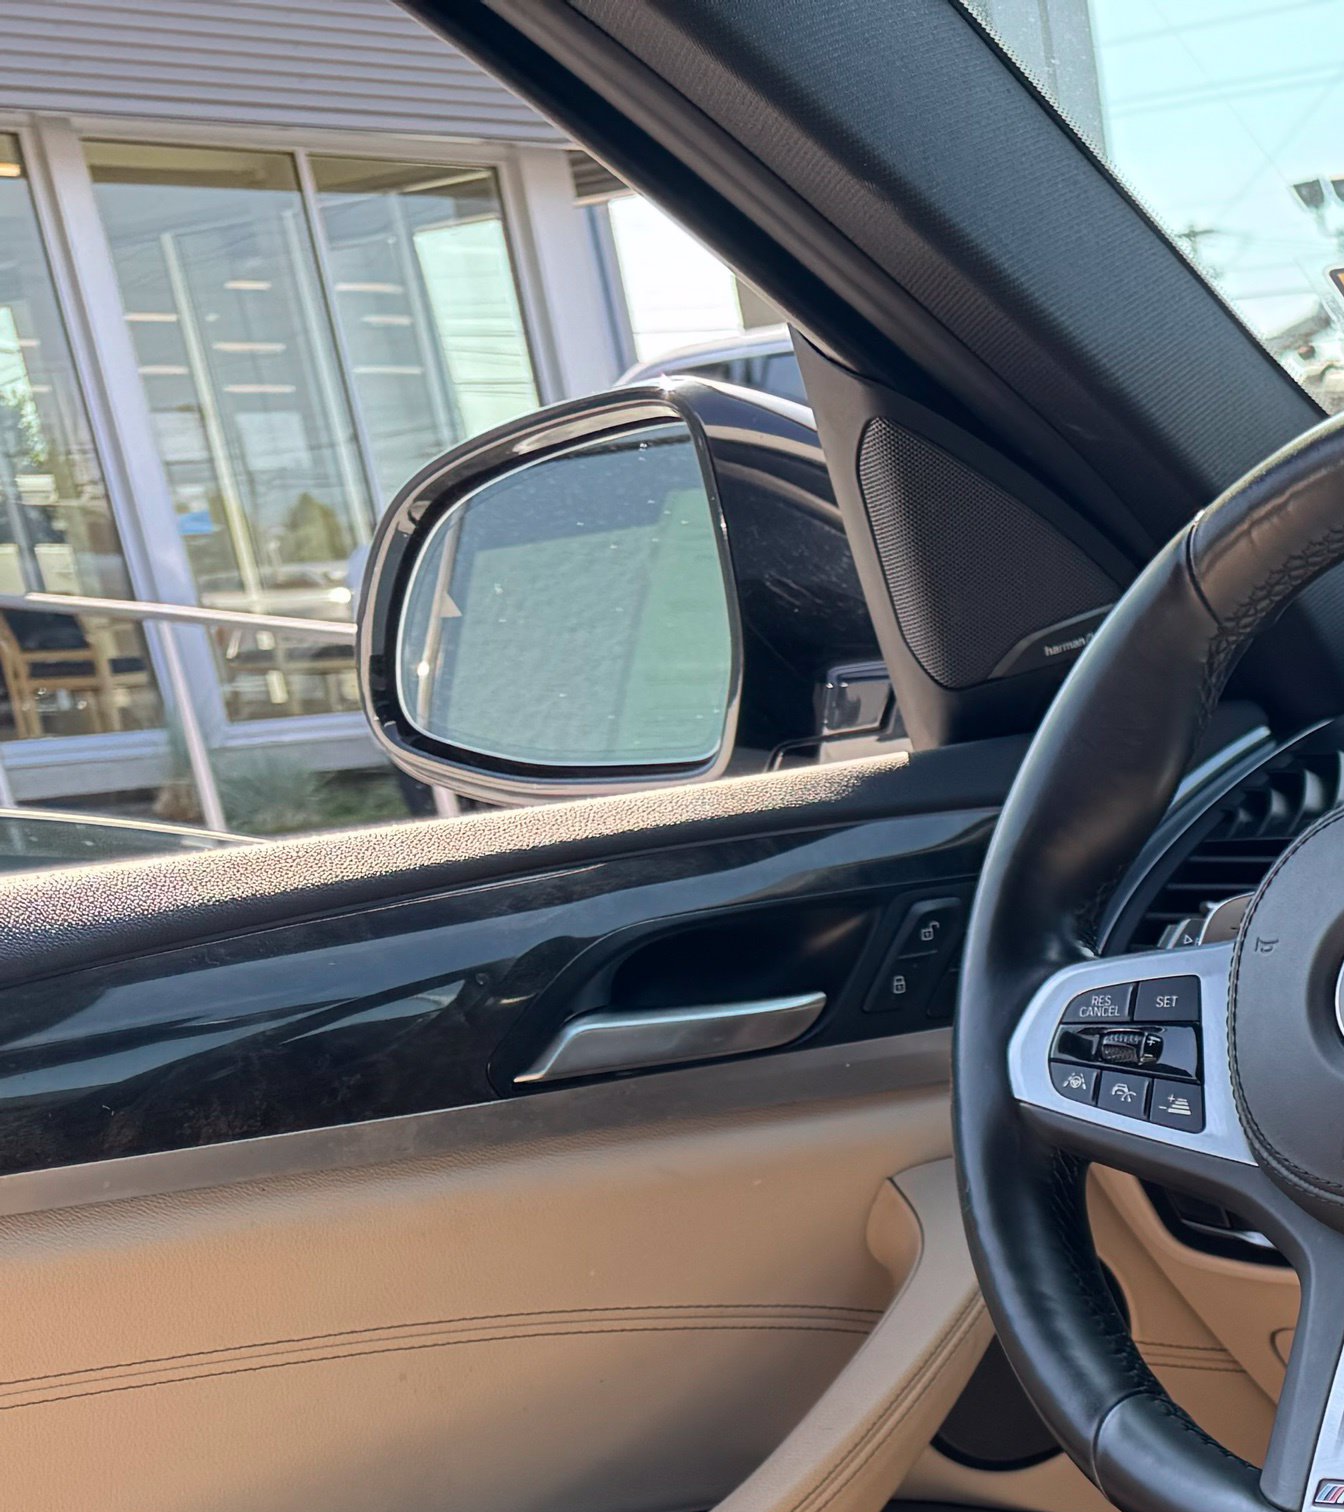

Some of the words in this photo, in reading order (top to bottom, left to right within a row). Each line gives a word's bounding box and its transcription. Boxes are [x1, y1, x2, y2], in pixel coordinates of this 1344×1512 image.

[1091, 995, 1112, 1007] RES
[1155, 995, 1179, 1008] SET
[1079, 1006, 1121, 1019] CANCEL
